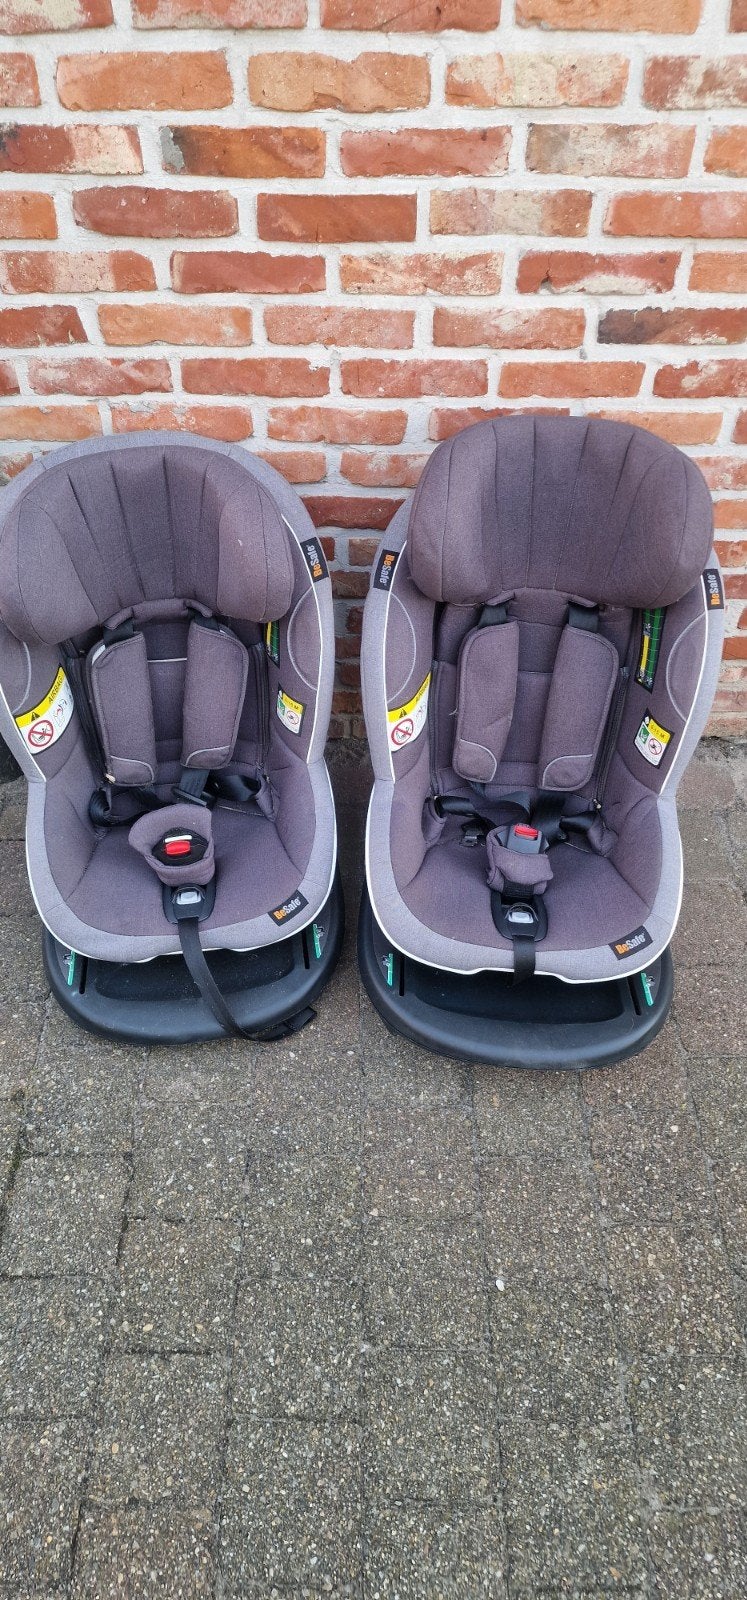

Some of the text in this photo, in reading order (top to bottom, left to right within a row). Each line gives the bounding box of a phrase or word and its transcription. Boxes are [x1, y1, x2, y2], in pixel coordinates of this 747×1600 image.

[307, 545, 323, 578] BeSafe
[380, 554, 395, 584] BeSafe
[707, 574, 721, 605] BeSafe
[273, 898, 301, 920] BeSafe
[615, 934, 646, 954] BeSafe
